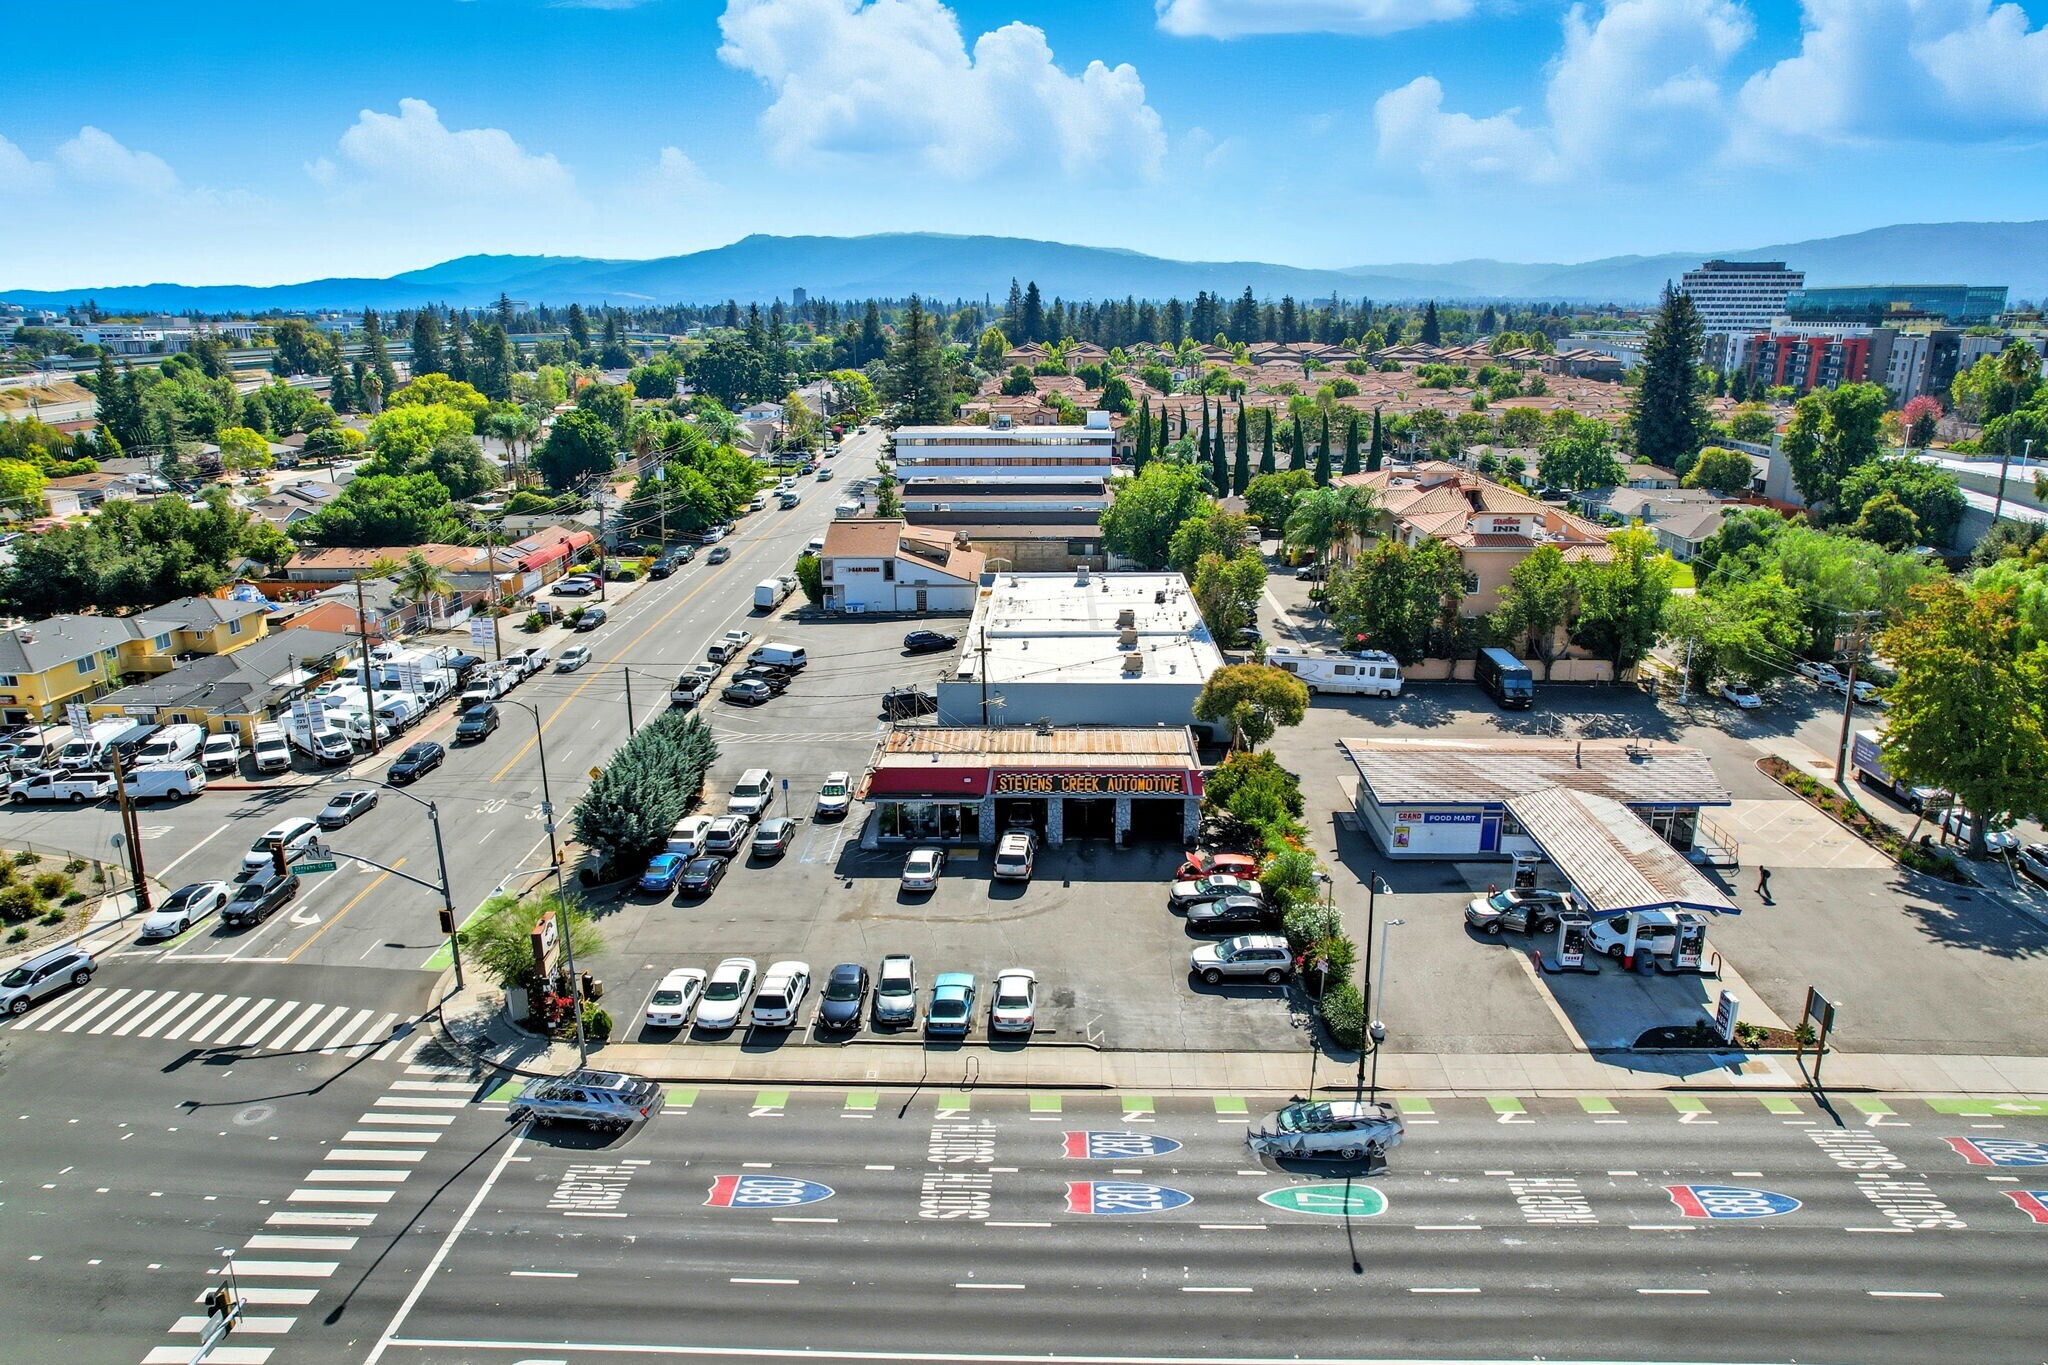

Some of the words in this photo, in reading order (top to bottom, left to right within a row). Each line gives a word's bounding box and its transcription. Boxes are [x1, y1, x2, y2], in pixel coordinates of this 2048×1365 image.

[999, 777, 1053, 791] STEVENS
[1062, 777, 1100, 792] CREEK
[1107, 777, 1180, 792] AUTOMOTIVE
[476, 799, 507, 813] 30
[927, 1124, 997, 1163] SOUTH
[1091, 1133, 1154, 1156] 280
[1804, 1129, 1907, 1170] SOUTH
[1973, 1140, 2048, 1163] 280
[546, 1164, 637, 1209] NORTH
[735, 1179, 806, 1204] 880
[918, 1173, 993, 1219] SOUTH
[1095, 1185, 1163, 1211] 280
[1506, 1178, 1600, 1223] NORTH
[1697, 1189, 1777, 1215] 880
[1854, 1181, 1969, 1230] SOUTH
